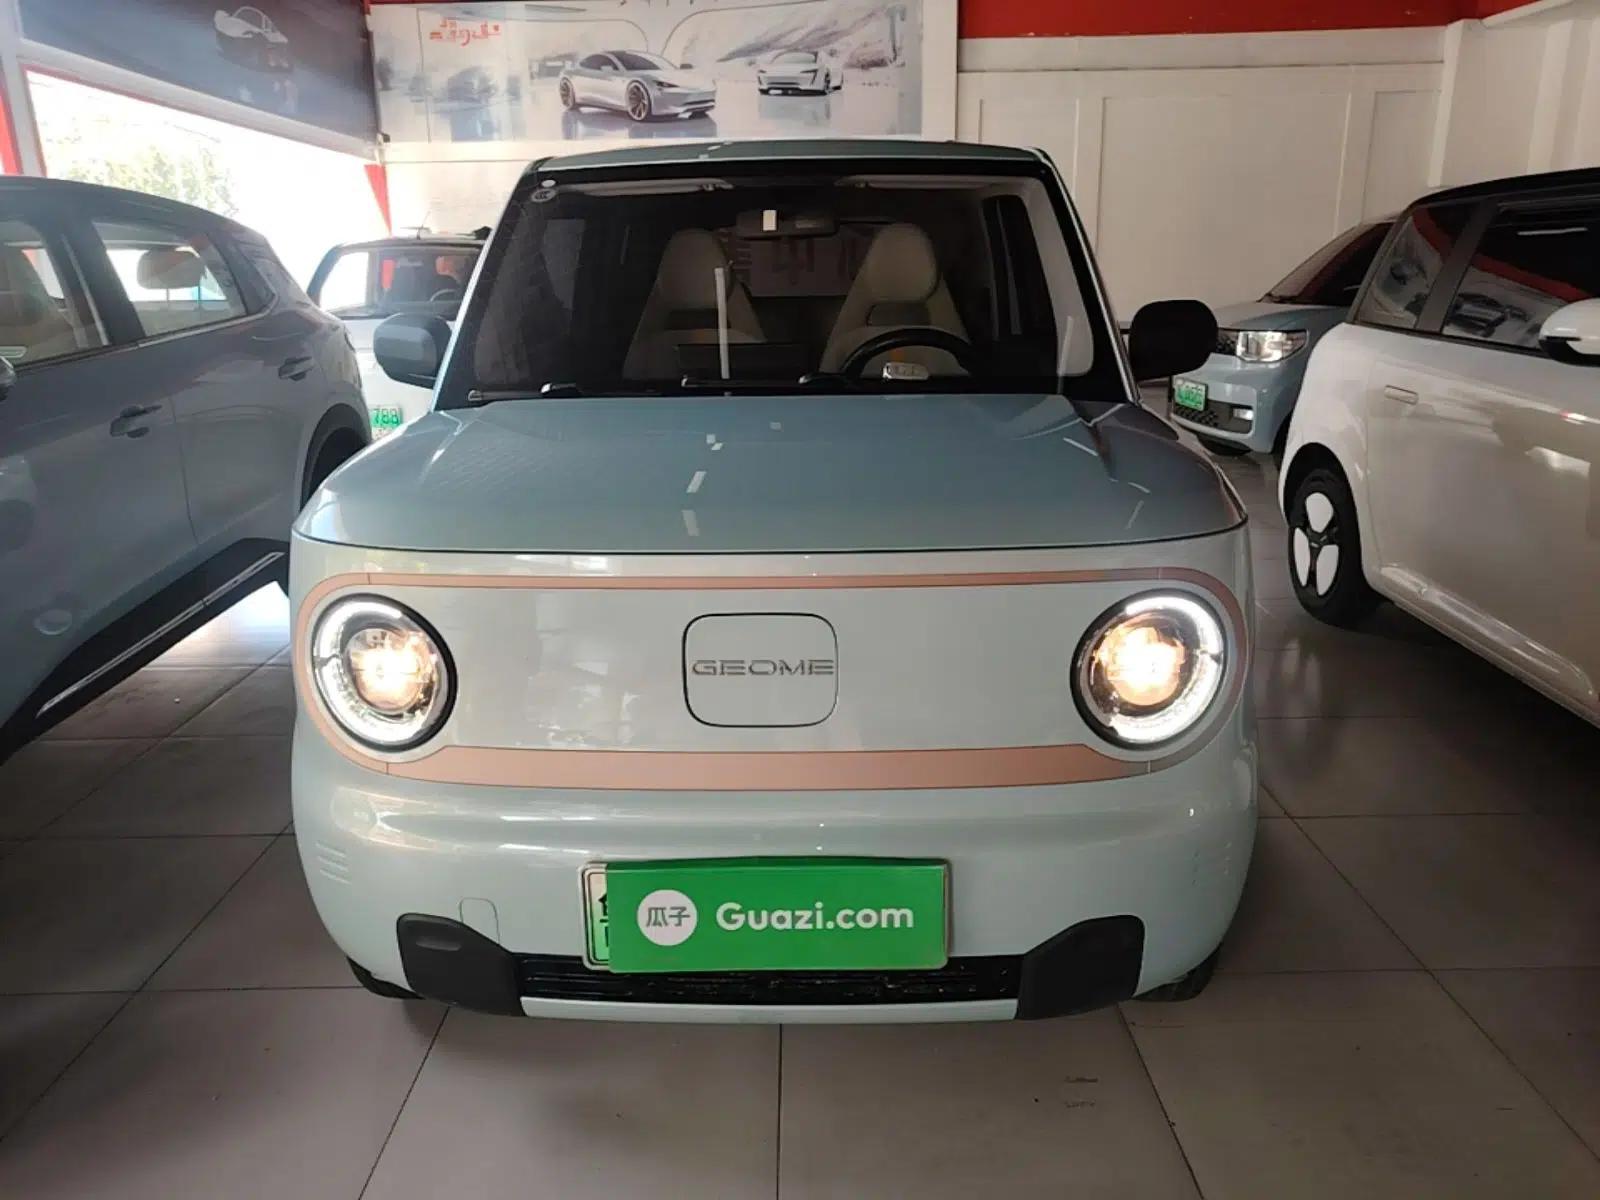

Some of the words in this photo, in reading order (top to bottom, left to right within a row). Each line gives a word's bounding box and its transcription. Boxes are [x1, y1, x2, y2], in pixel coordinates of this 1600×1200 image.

[692, 659, 835, 676] GEOME
[645, 906, 691, 927] 瓜子
[715, 901, 914, 932] Guazi.com
